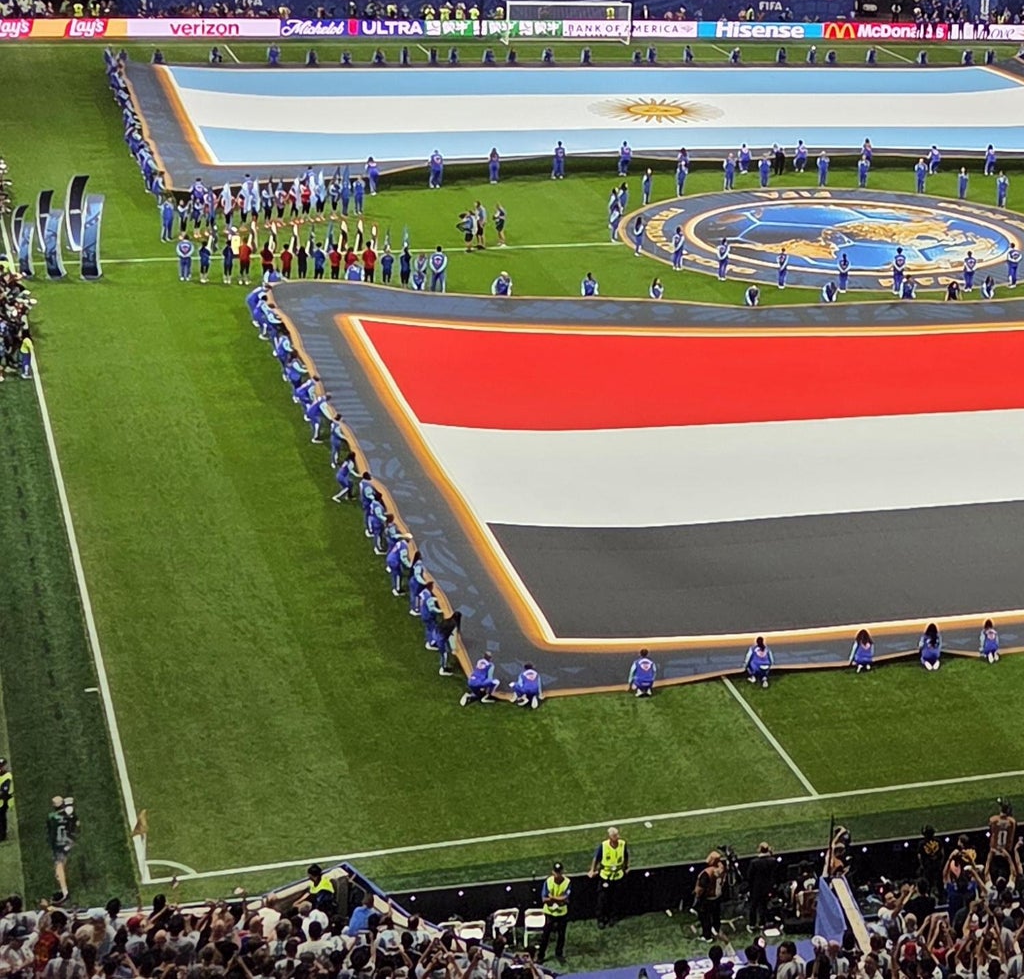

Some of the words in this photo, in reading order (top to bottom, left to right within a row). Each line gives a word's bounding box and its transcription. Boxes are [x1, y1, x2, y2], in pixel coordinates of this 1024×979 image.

[758, 1, 783, 11] FIFA
[69, 18, 105, 37] Lay's
[170, 20, 239, 36] verizon
[281, 19, 344, 36] Michelob
[362, 21, 423, 36] ULTRA
[567, 24, 601, 34] BANK
[605, 25, 620, 33] OF
[623, 25, 679, 33] AMERICA
[716, 21, 805, 38] Hisense
